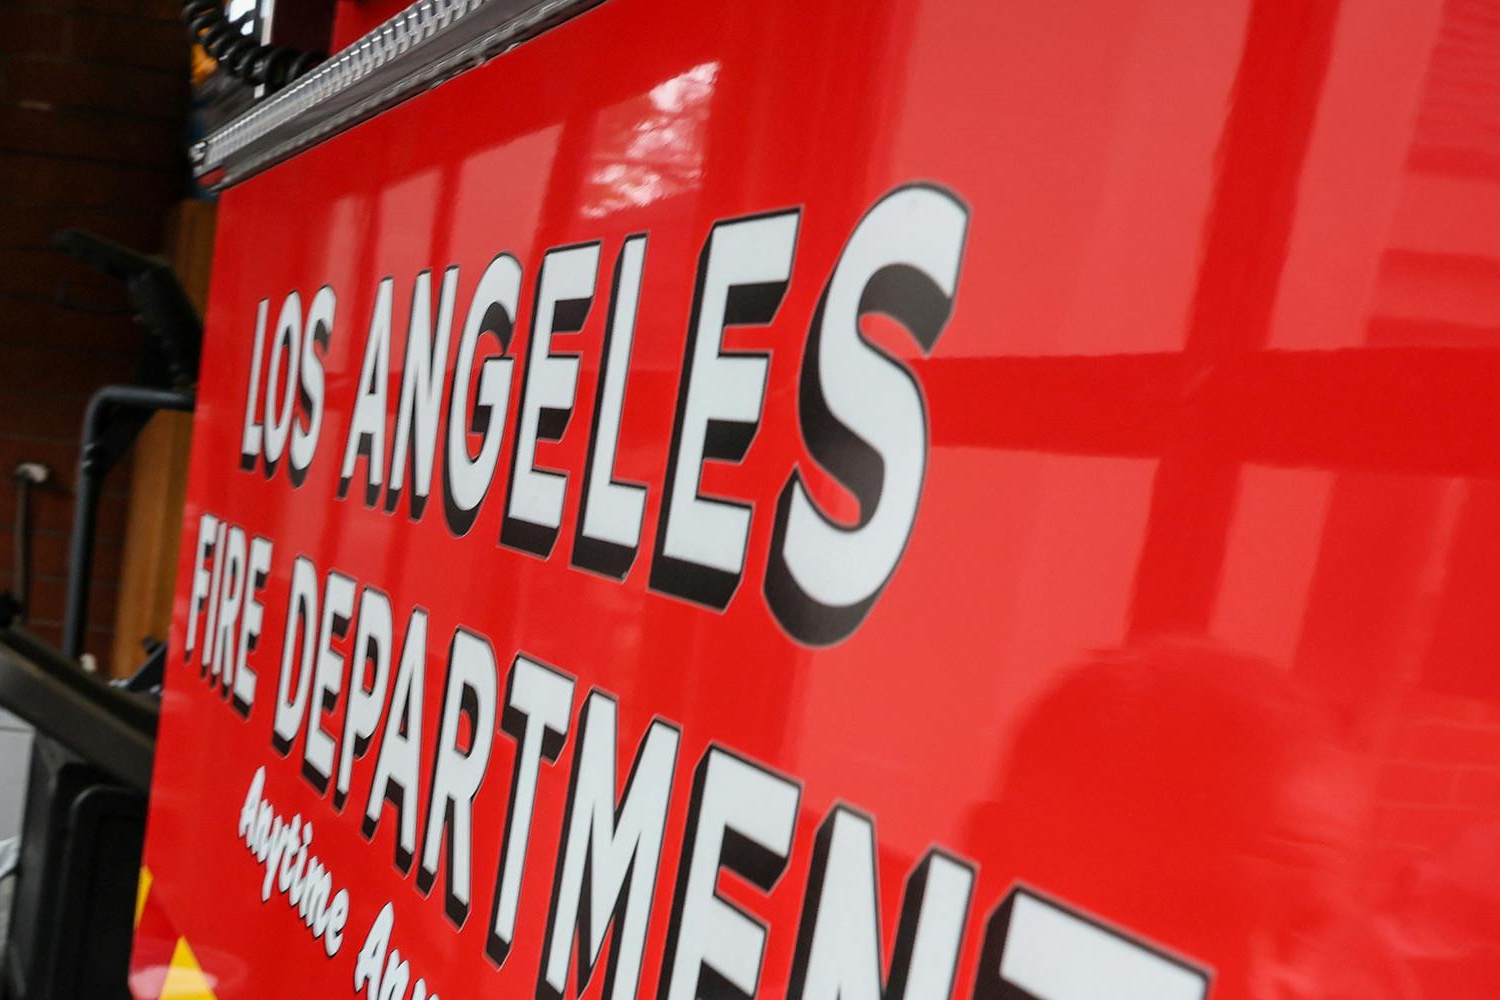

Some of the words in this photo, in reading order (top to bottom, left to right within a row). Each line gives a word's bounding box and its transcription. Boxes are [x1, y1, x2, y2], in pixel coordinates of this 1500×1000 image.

[240, 284, 337, 488] LOS
[337, 181, 972, 648] ANGELES
[184, 511, 272, 721] FIRE
[238, 765, 351, 958] Anytime
